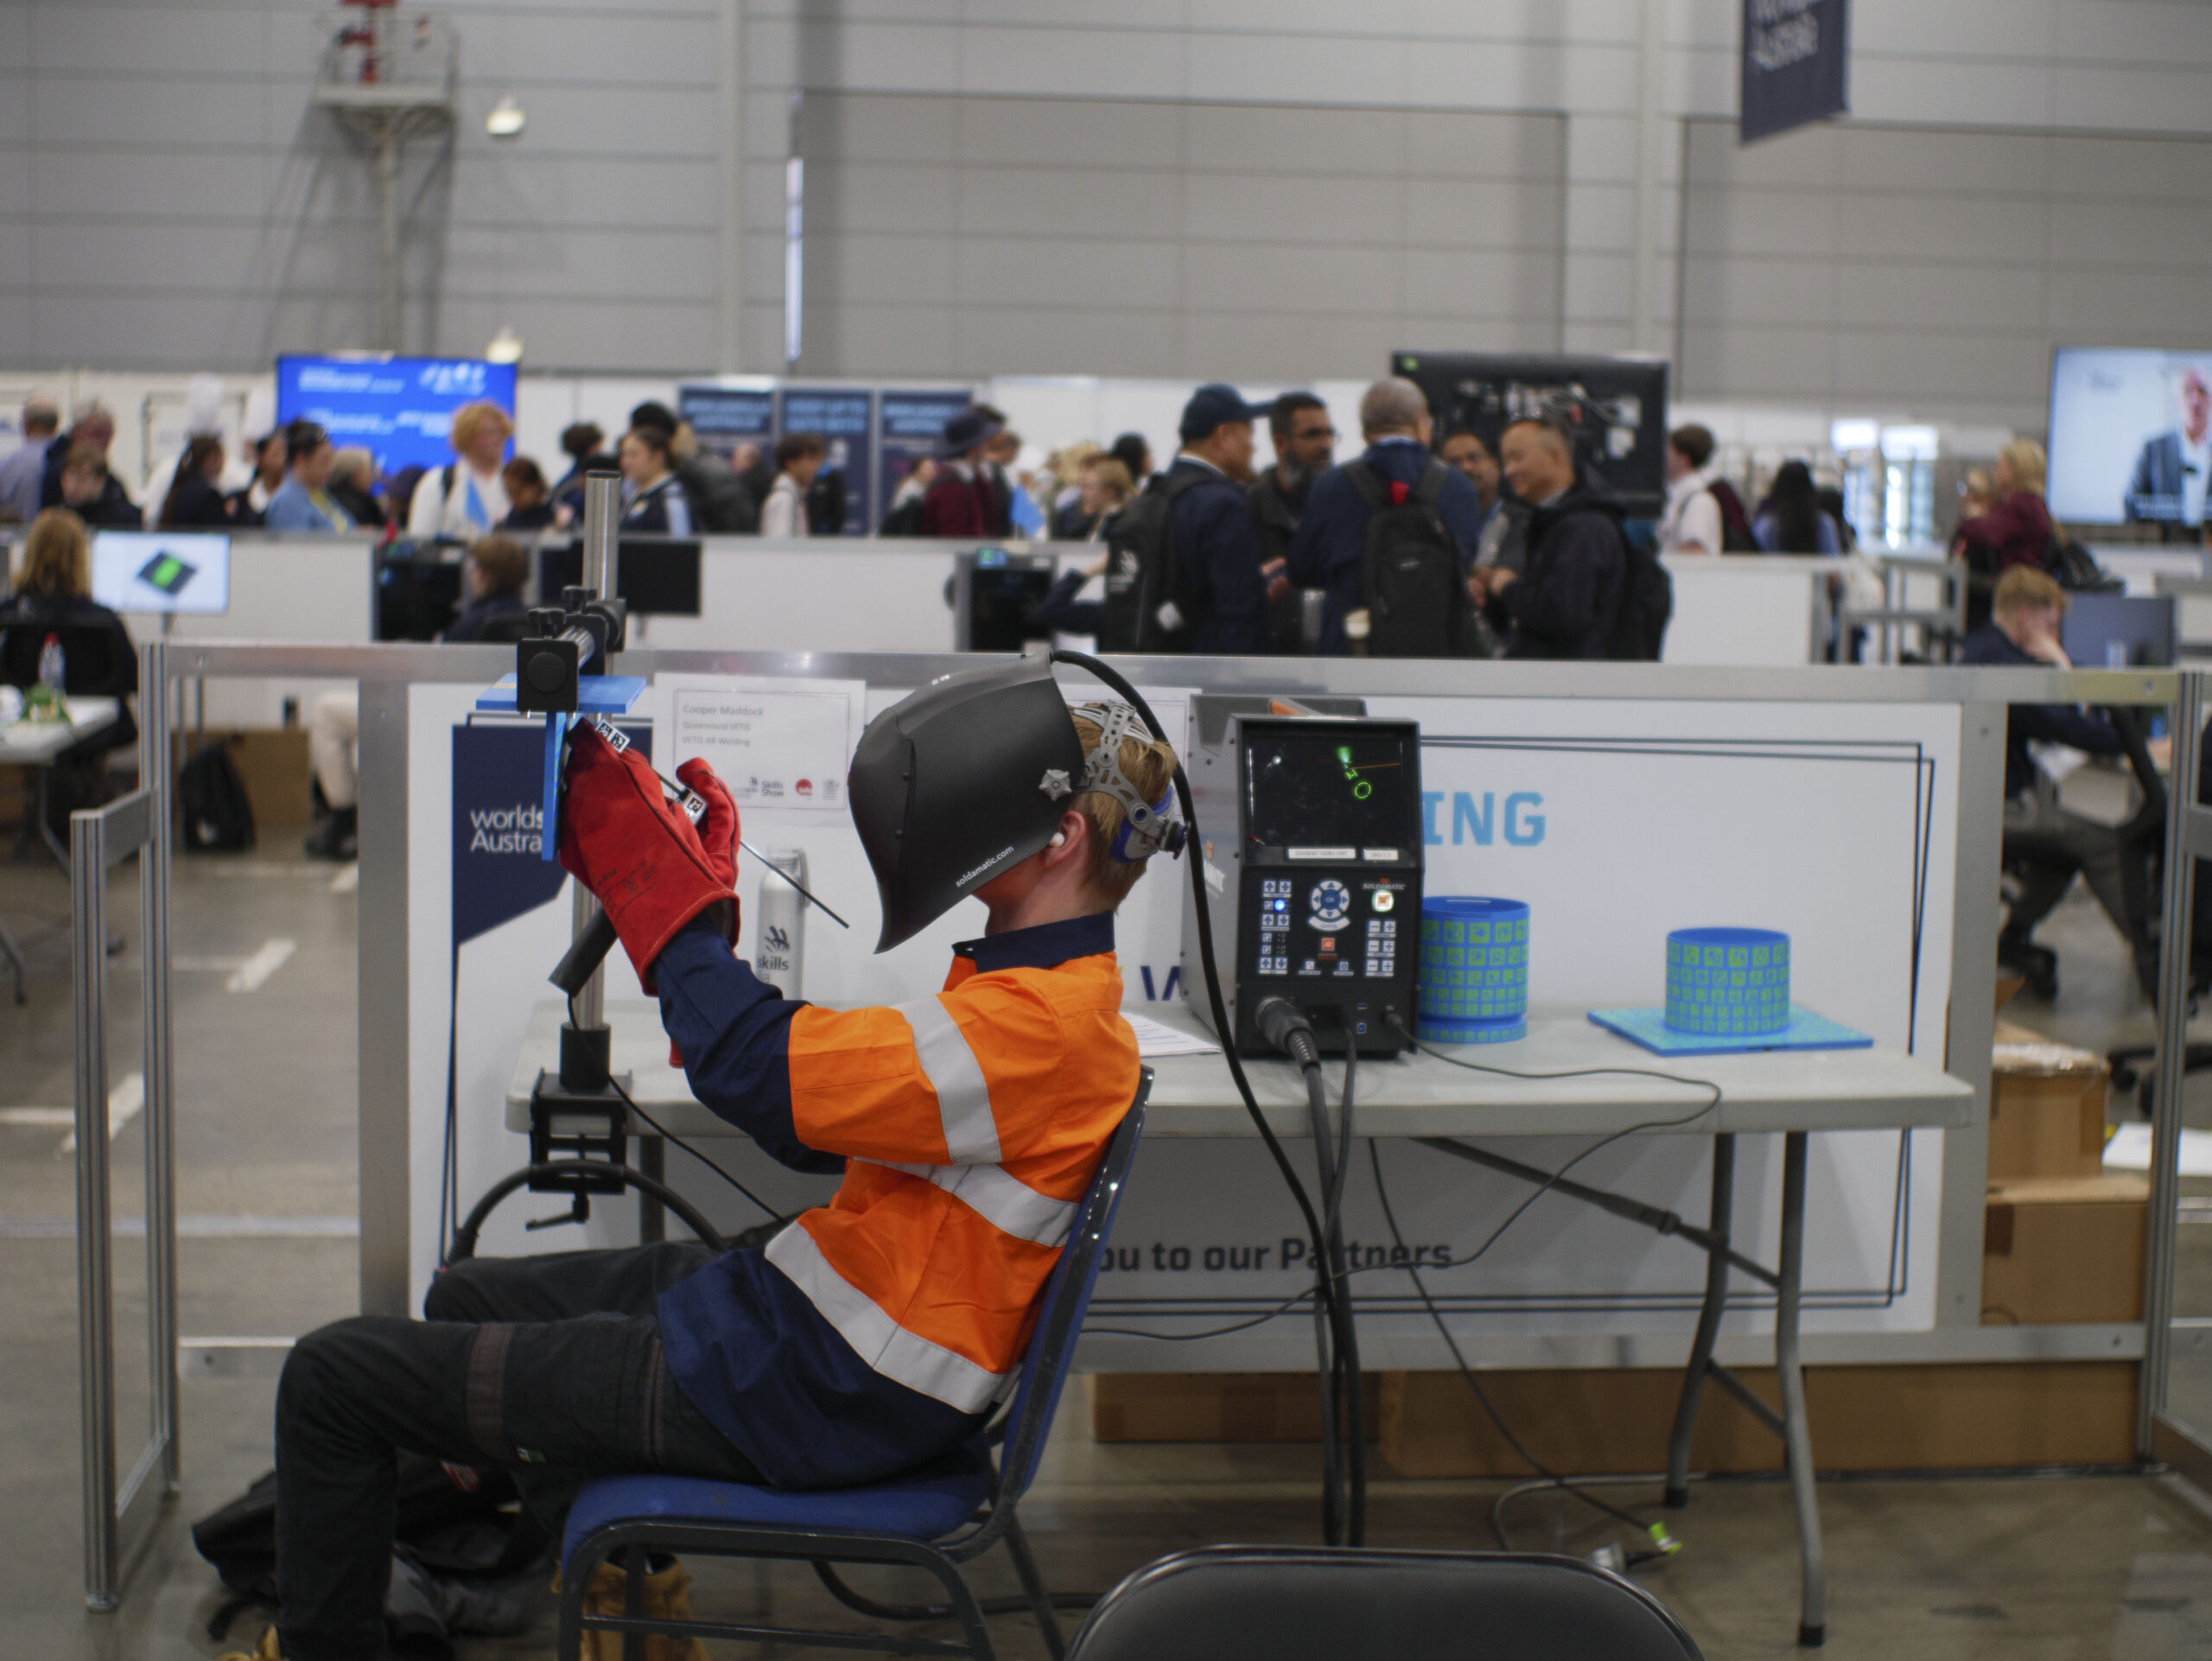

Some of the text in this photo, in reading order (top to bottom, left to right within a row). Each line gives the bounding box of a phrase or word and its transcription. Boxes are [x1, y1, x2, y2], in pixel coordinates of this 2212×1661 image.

[683, 704, 764, 716] Cooper Maddock
[761, 780, 784, 789] Skills
[761, 788, 784, 797] Show
[1421, 792, 1546, 846] ING
[470, 830, 542, 852] Austra
[955, 846, 1014, 888] soldamatic.com
[1153, 1243, 1192, 1271] to
[1204, 1247, 1270, 1271] our
[1281, 1238, 1452, 1270] Patners
